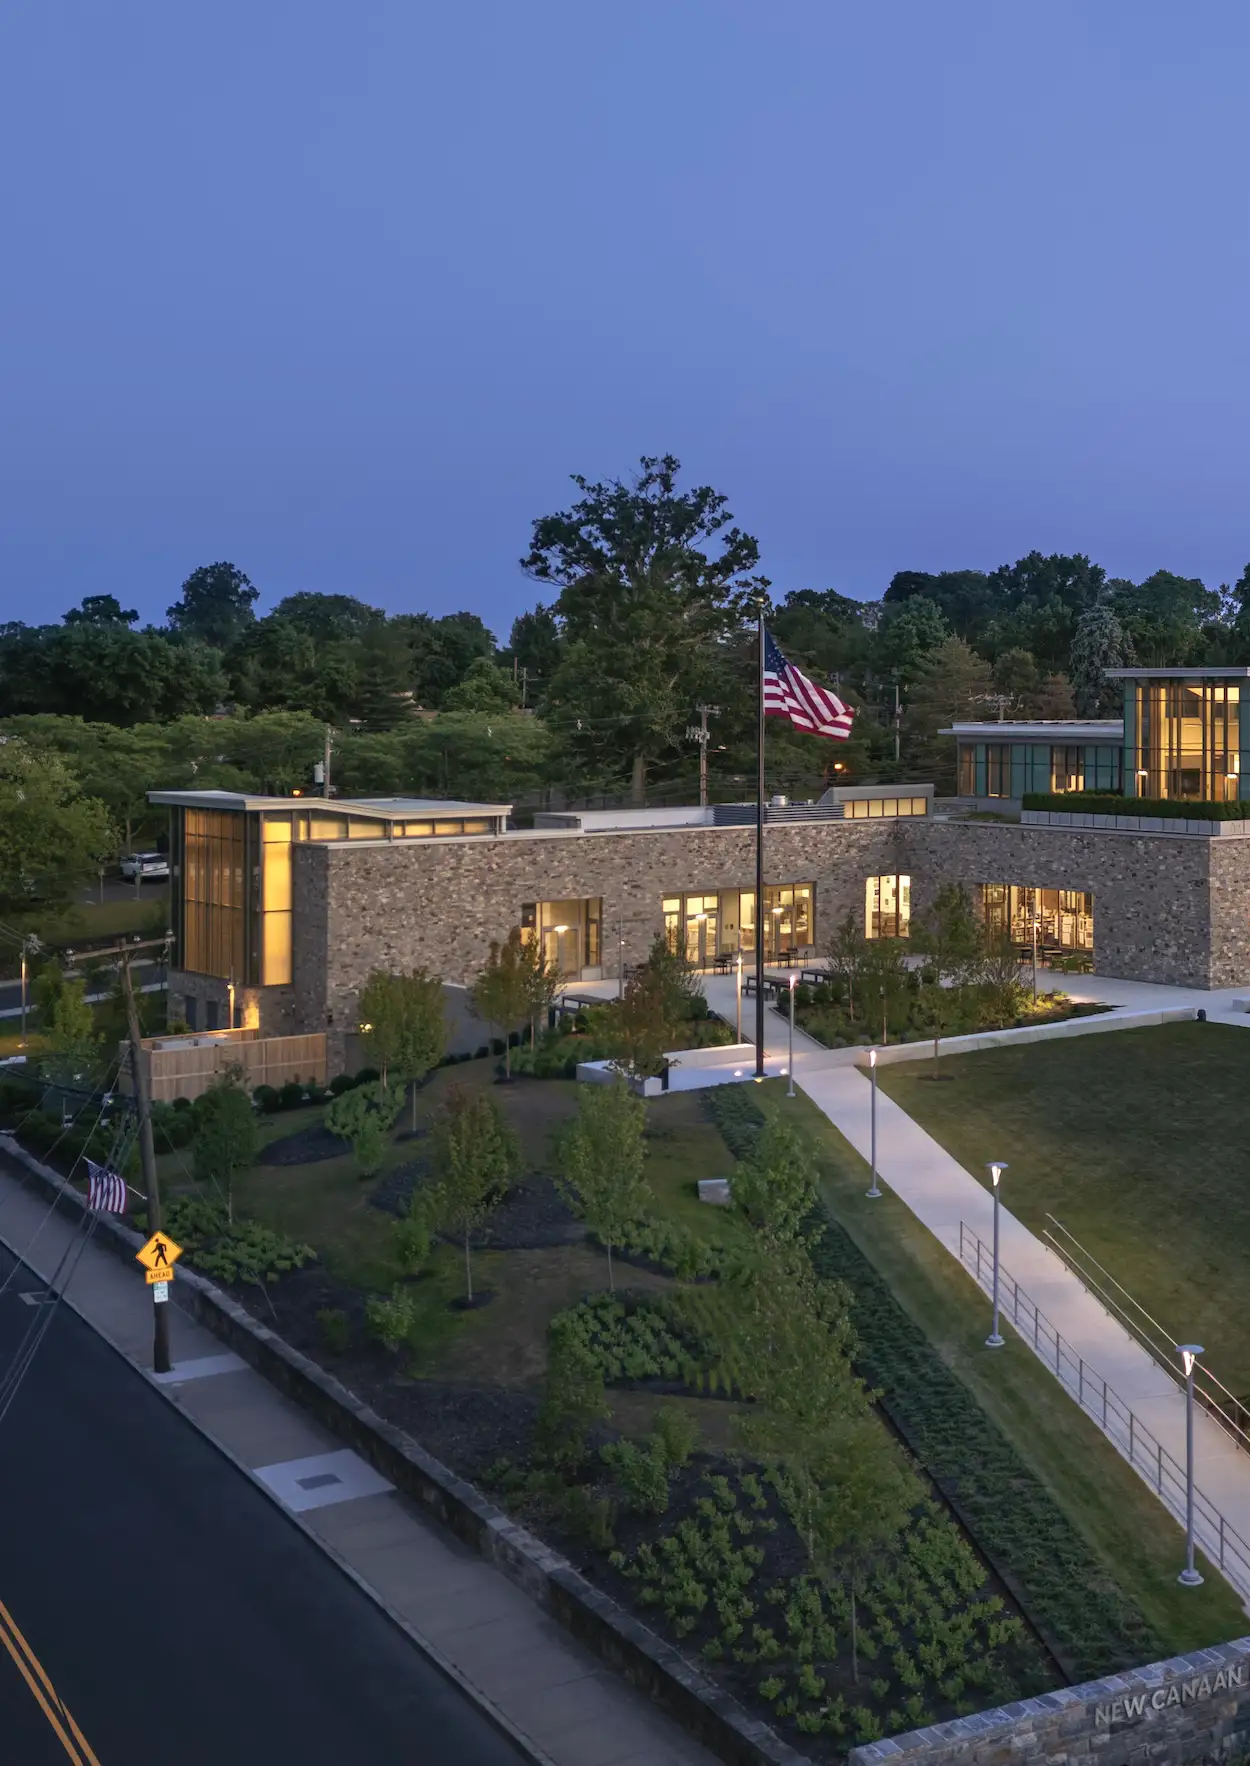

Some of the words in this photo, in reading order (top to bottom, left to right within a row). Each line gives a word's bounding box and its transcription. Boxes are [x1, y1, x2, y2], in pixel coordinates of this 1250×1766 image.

[150, 1271, 170, 1279] AHEAD
[1095, 1694, 1146, 1727] NEW
[1152, 1666, 1242, 1710] CANAAN
